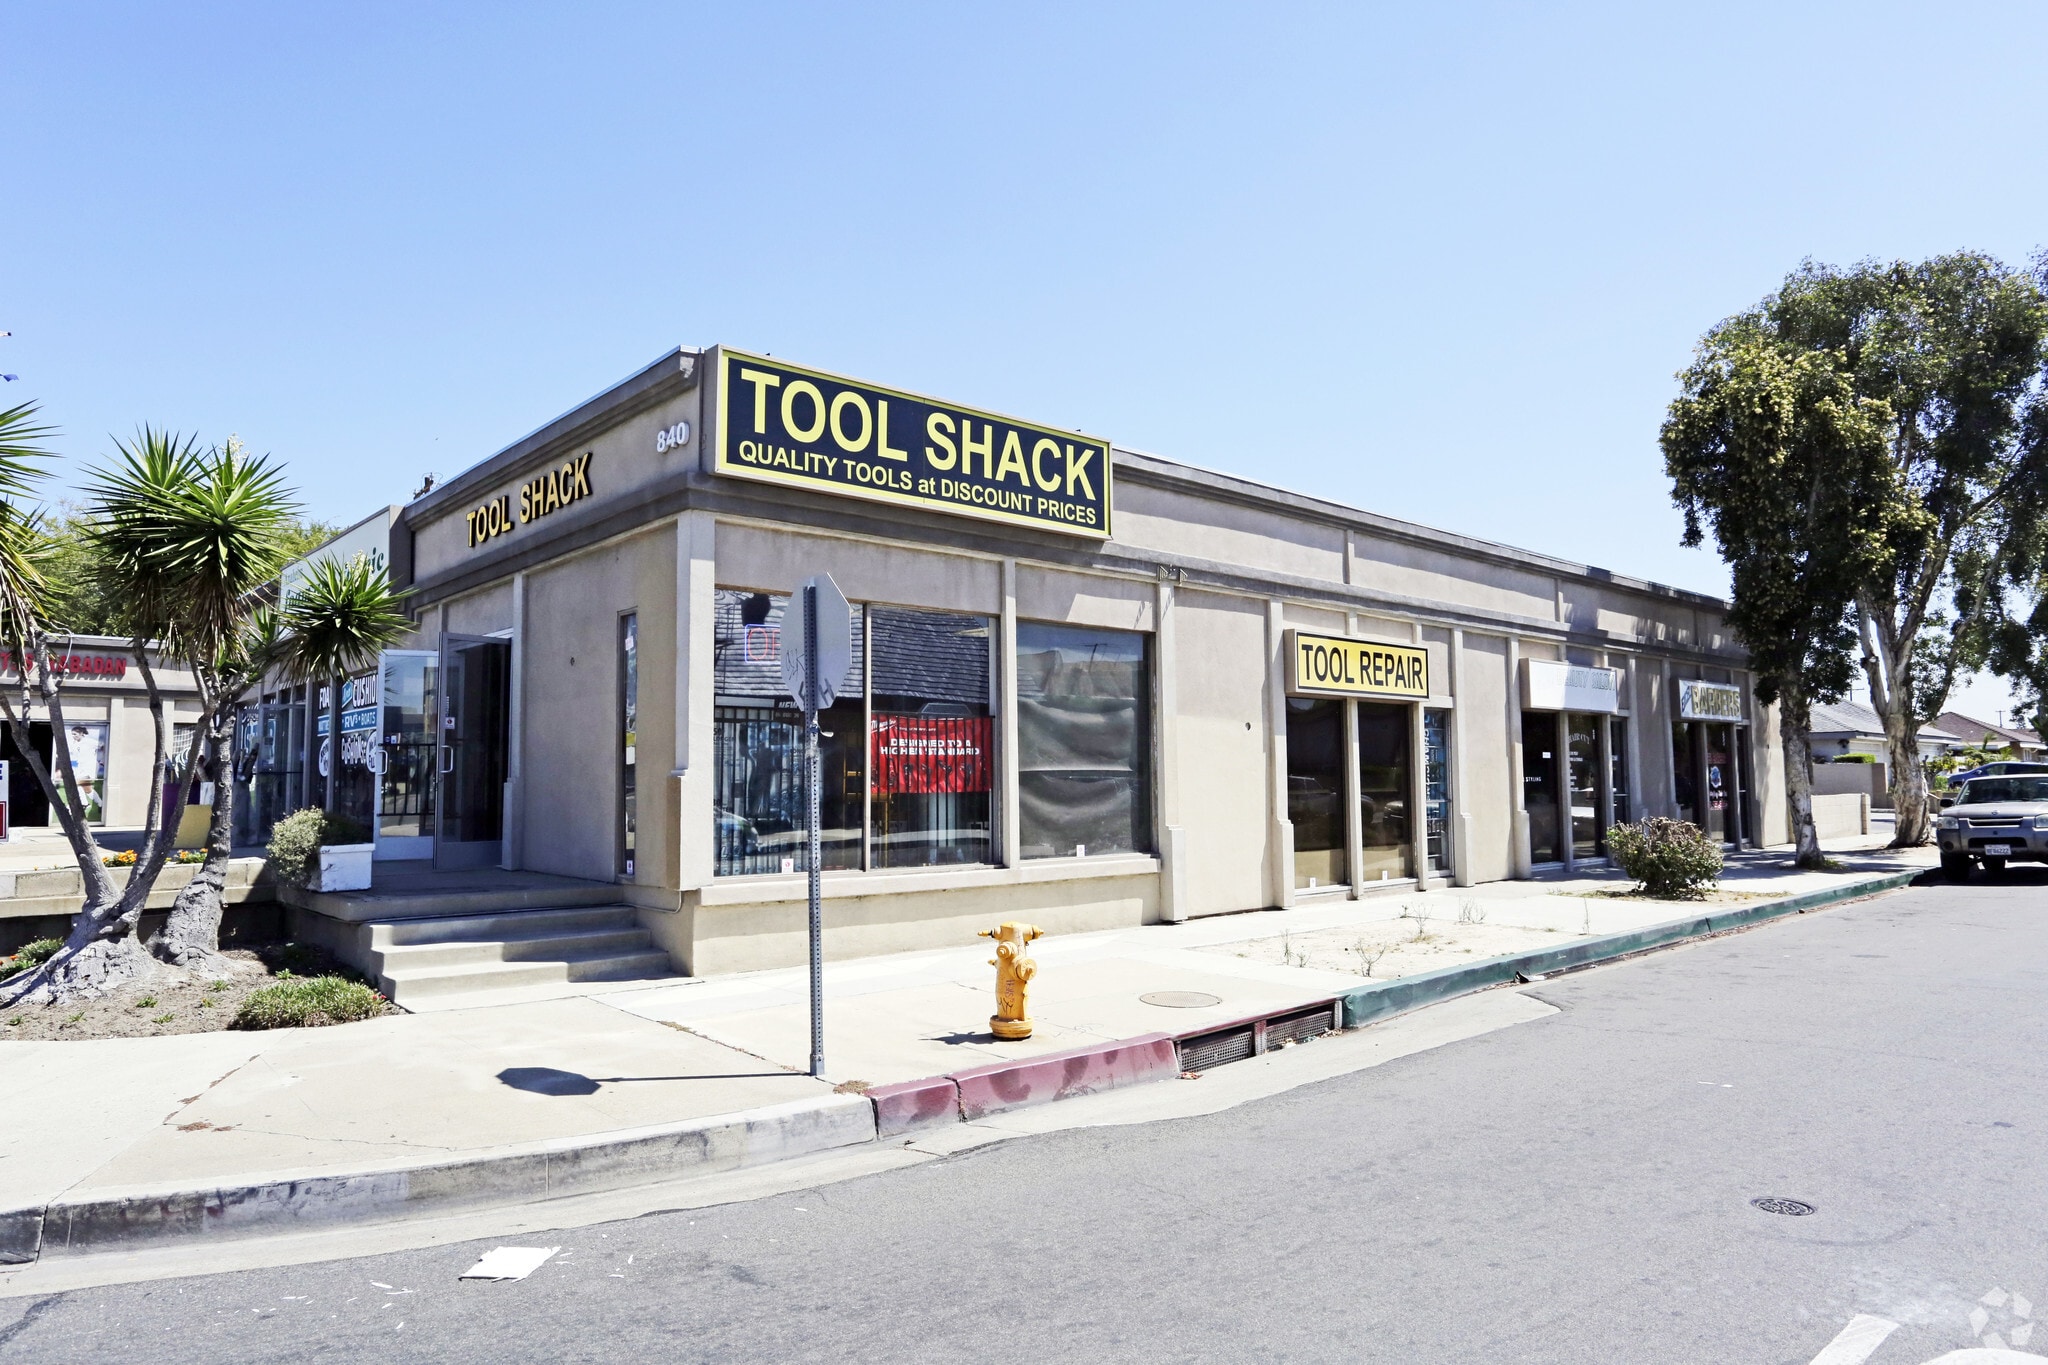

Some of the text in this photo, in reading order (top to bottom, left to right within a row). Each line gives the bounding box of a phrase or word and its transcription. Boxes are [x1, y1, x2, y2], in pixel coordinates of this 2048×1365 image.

[657, 421, 690, 453] 840
[740, 367, 1097, 501] TOOL SHACK
[738, 440, 1097, 525] QUALITY TOOLS at DISCOUNT PRICES
[466, 452, 592, 547] TOOL SHACK
[1301, 643, 1424, 690] TOOL REPAIR
[319, 687, 330, 710] FOA
[1691, 685, 1741, 717] BARBERS
[880, 746, 980, 756] HIGHER STANDARD
[890, 738, 945, 747] DESIGNED
[947, 739, 963, 747] TO
